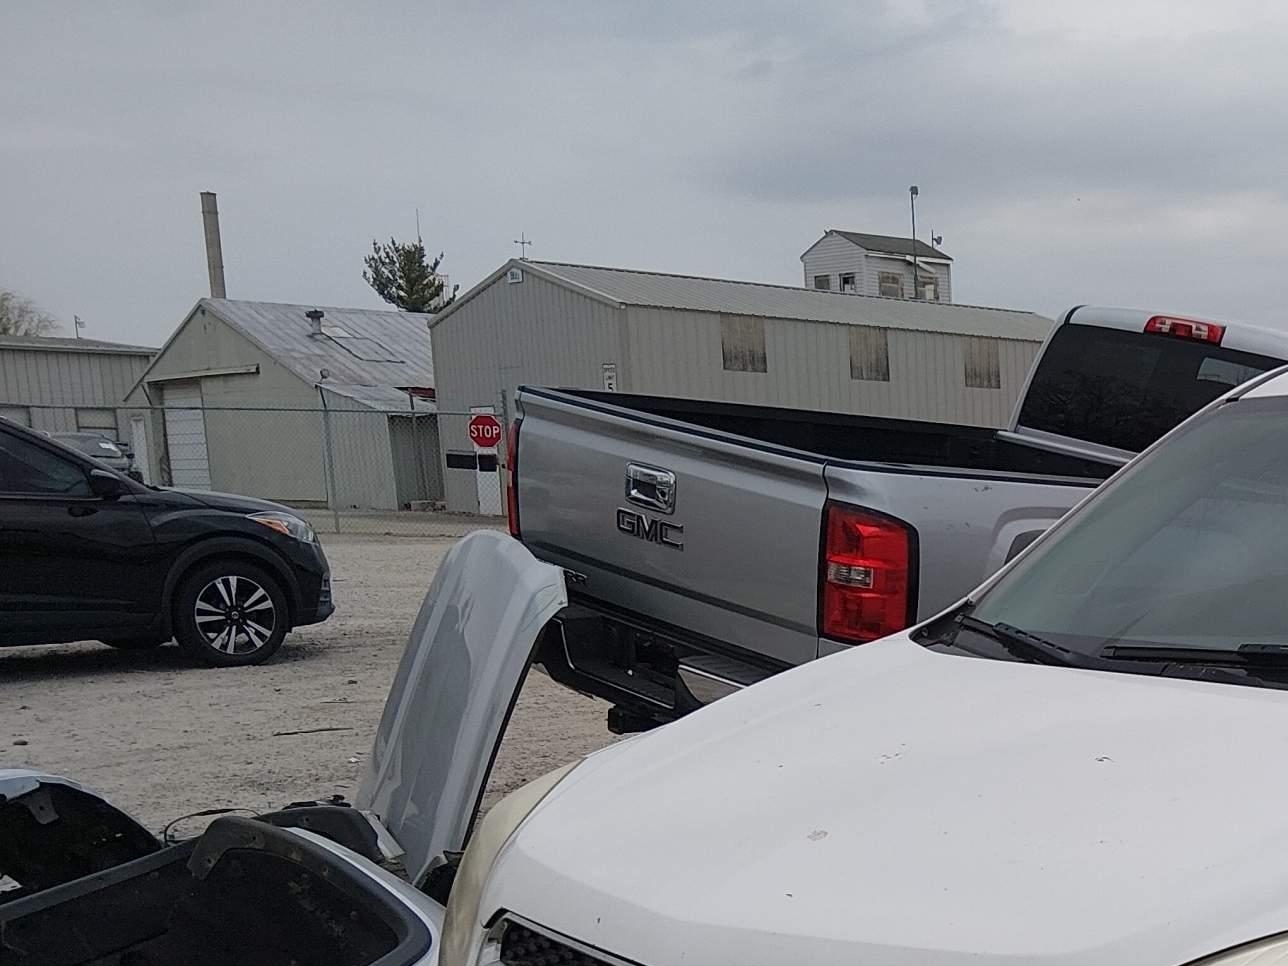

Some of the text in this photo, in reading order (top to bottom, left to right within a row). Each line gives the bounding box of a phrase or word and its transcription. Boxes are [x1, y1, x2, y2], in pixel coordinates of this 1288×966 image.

[607, 382, 614, 393] 5
[470, 424, 500, 438] STOP
[616, 508, 684, 551] GMC
